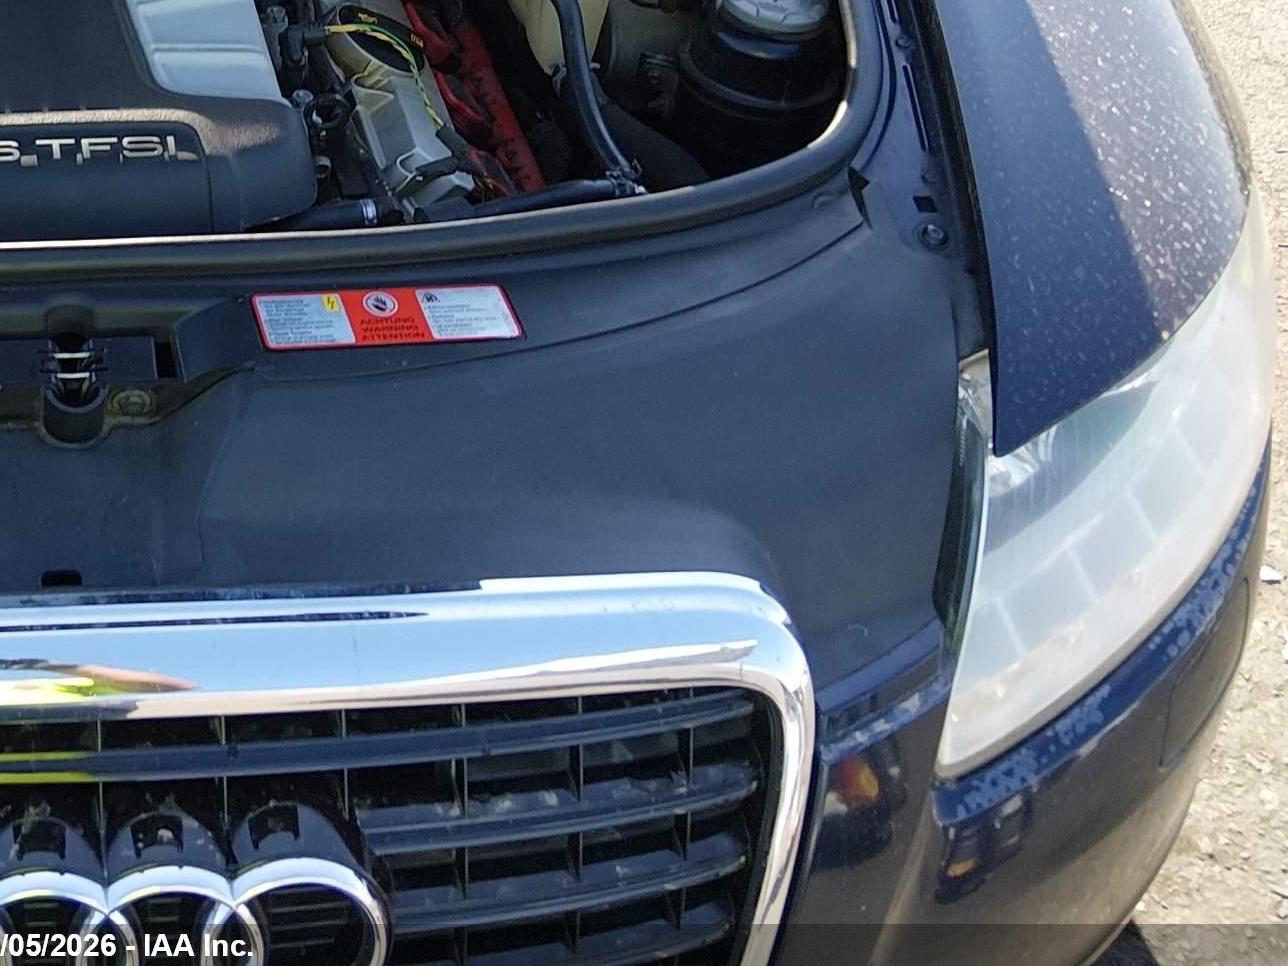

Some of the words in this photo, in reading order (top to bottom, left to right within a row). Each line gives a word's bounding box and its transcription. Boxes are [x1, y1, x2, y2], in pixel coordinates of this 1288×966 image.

[35, 134, 176, 160] TFSI
[361, 324, 418, 333] WARNING
[362, 332, 425, 341] ATTENTION
